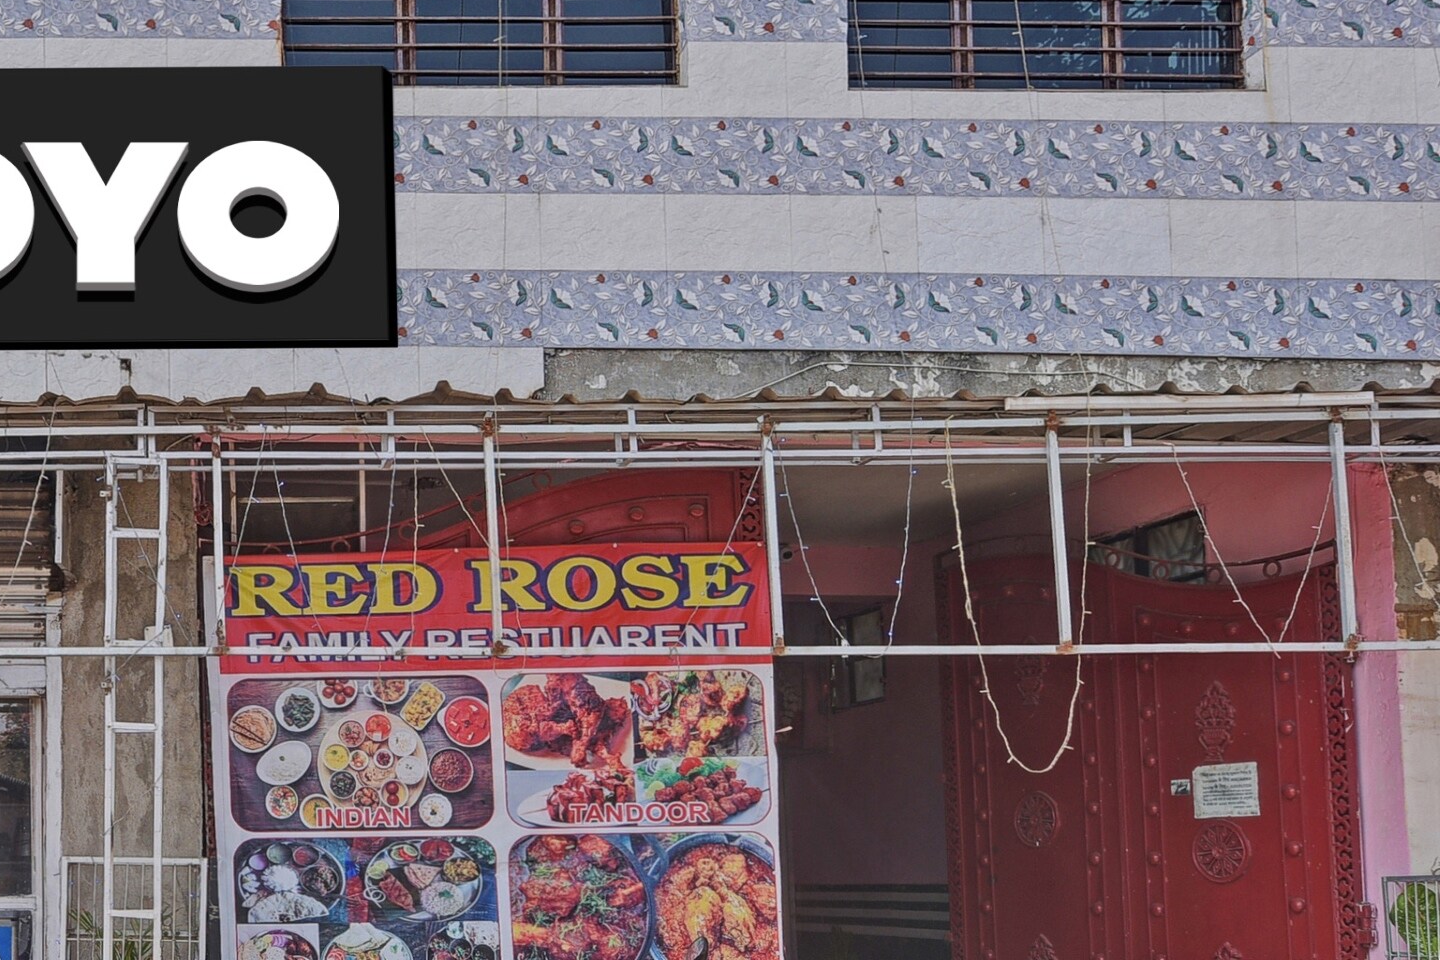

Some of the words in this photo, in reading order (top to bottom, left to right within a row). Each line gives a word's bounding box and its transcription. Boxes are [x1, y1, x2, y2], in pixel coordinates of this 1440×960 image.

[229, 561, 439, 617] RED
[471, 552, 752, 614] ROSE
[248, 630, 412, 663] FAMILY
[315, 806, 412, 828] INDIAN
[569, 802, 710, 824] TANDOOR
